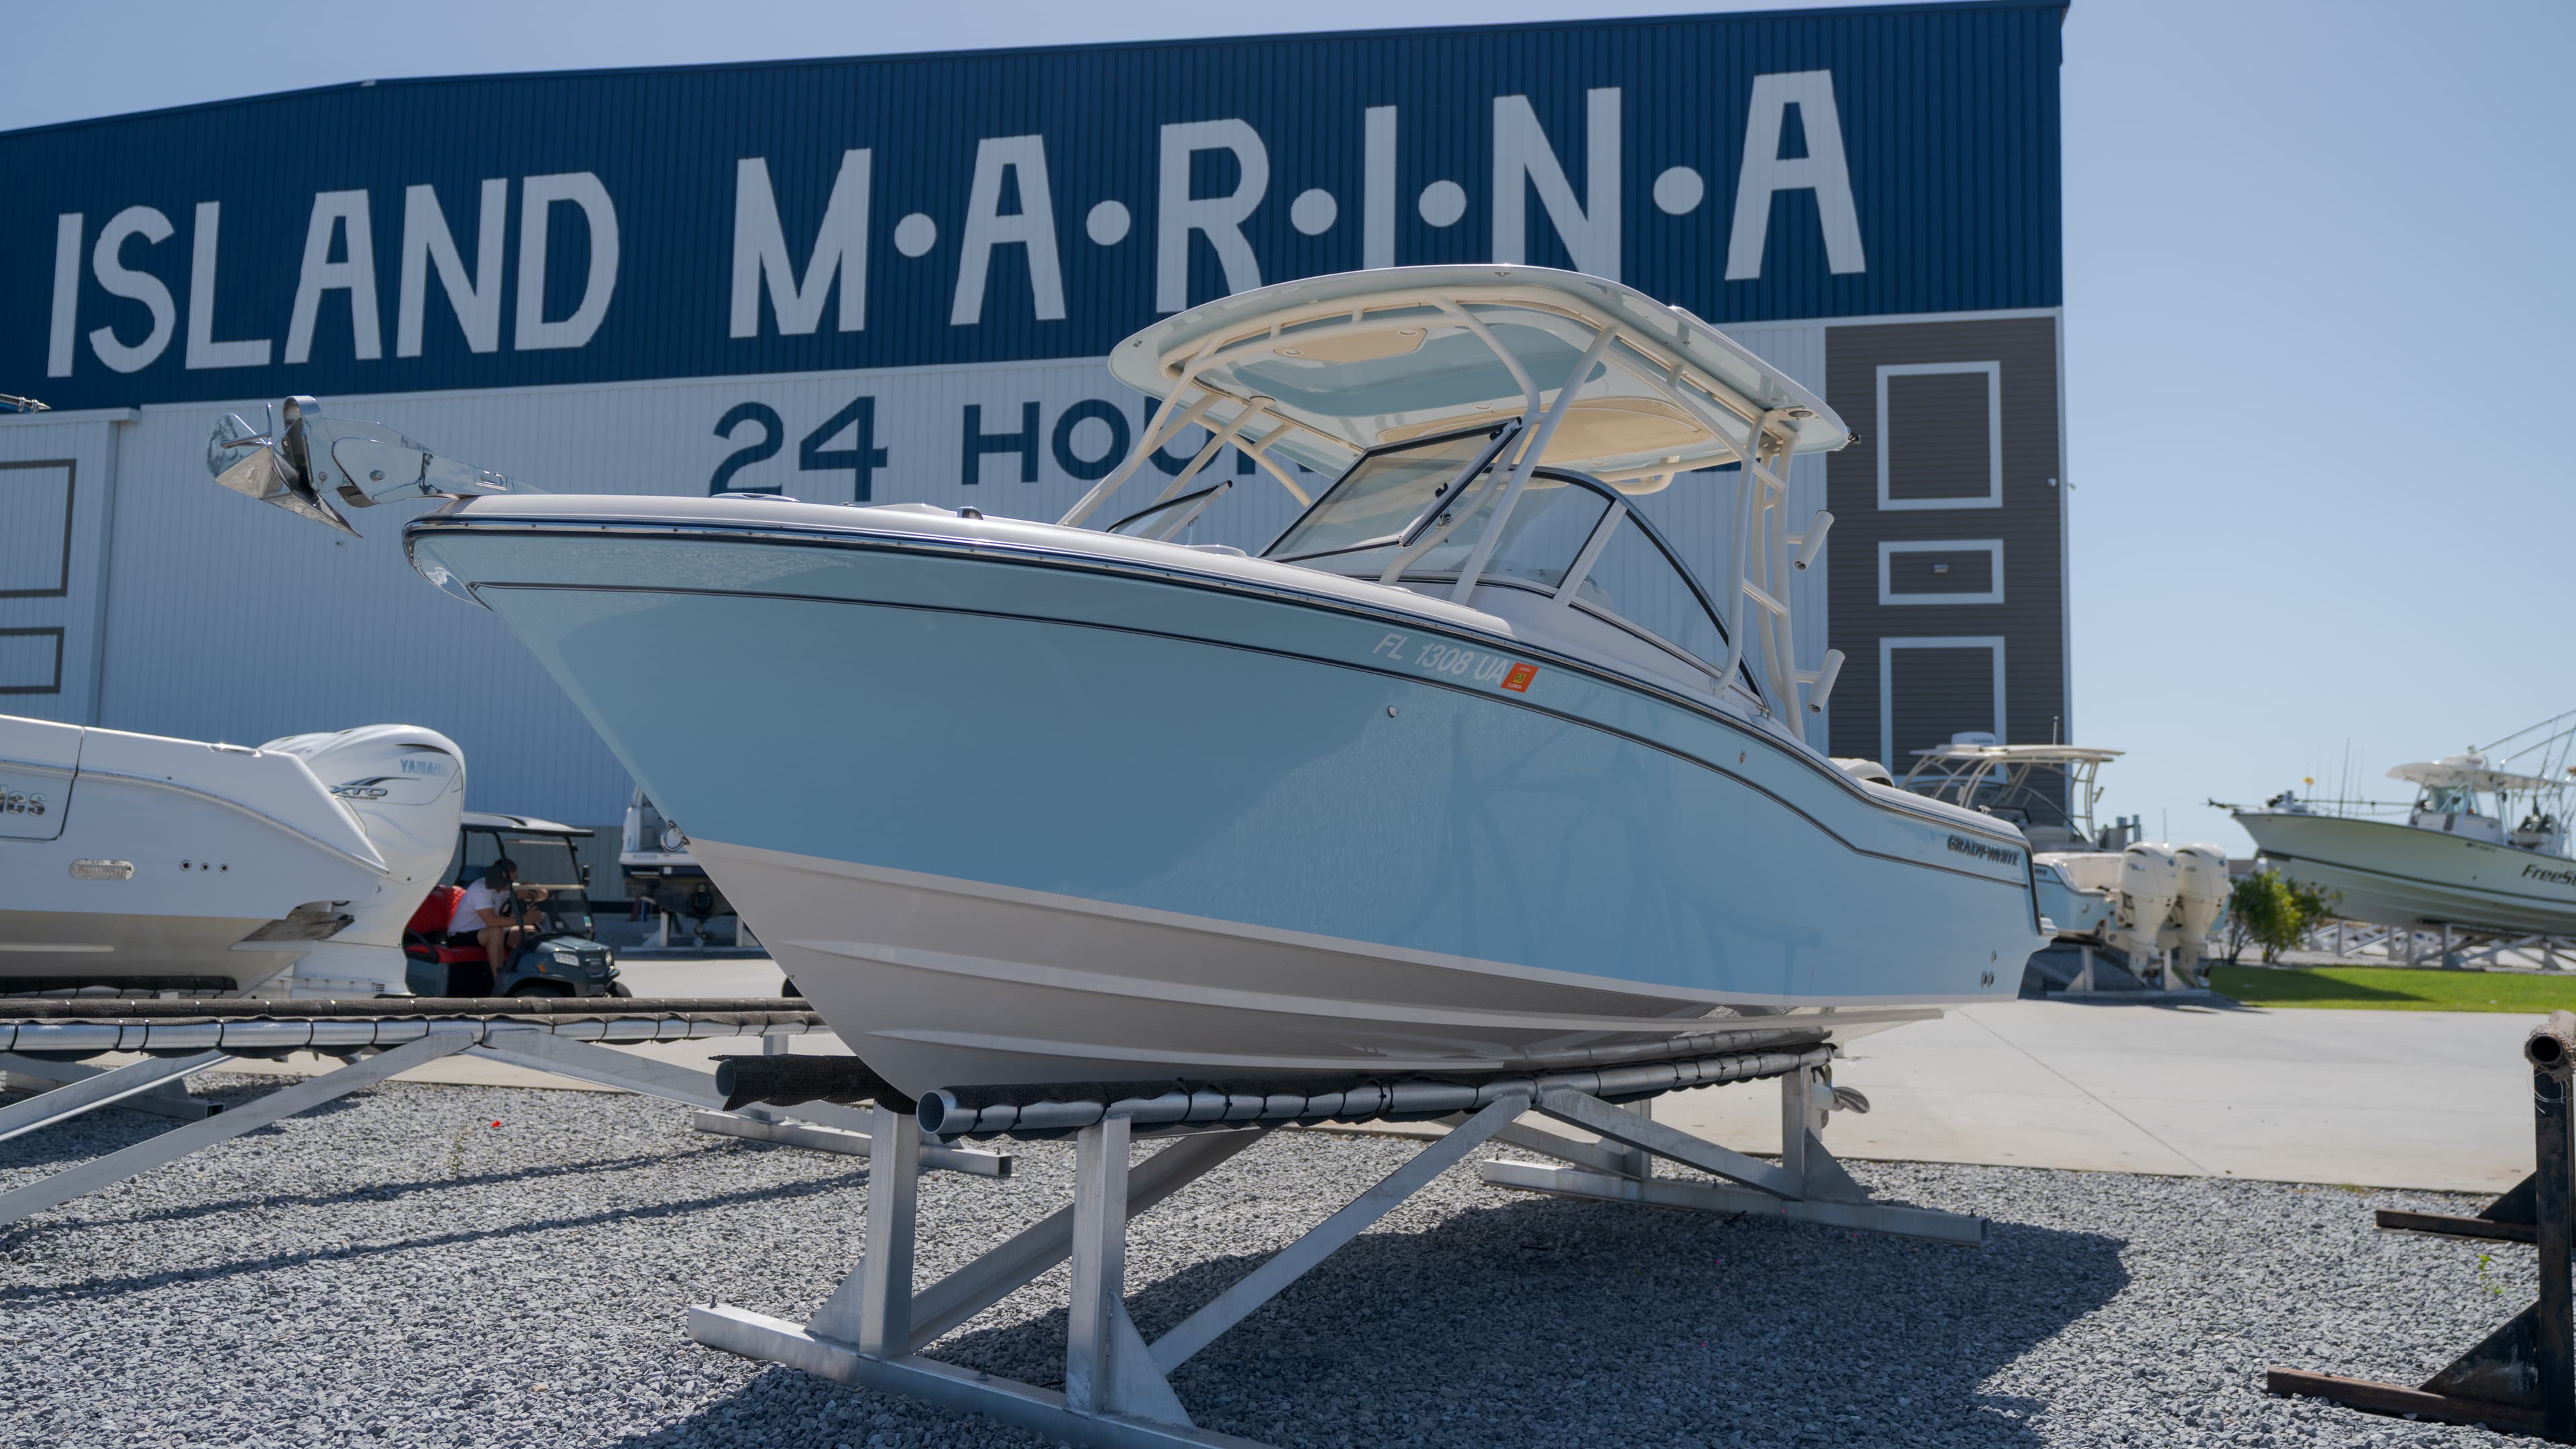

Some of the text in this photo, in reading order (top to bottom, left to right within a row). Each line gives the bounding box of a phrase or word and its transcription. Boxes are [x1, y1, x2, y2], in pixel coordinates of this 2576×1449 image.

[48, 171, 620, 378] ISLAND
[710, 396, 1316, 502] 24 HOU
[1372, 633, 1509, 684] FL 1308 UA
[329, 785, 388, 797] XTO
